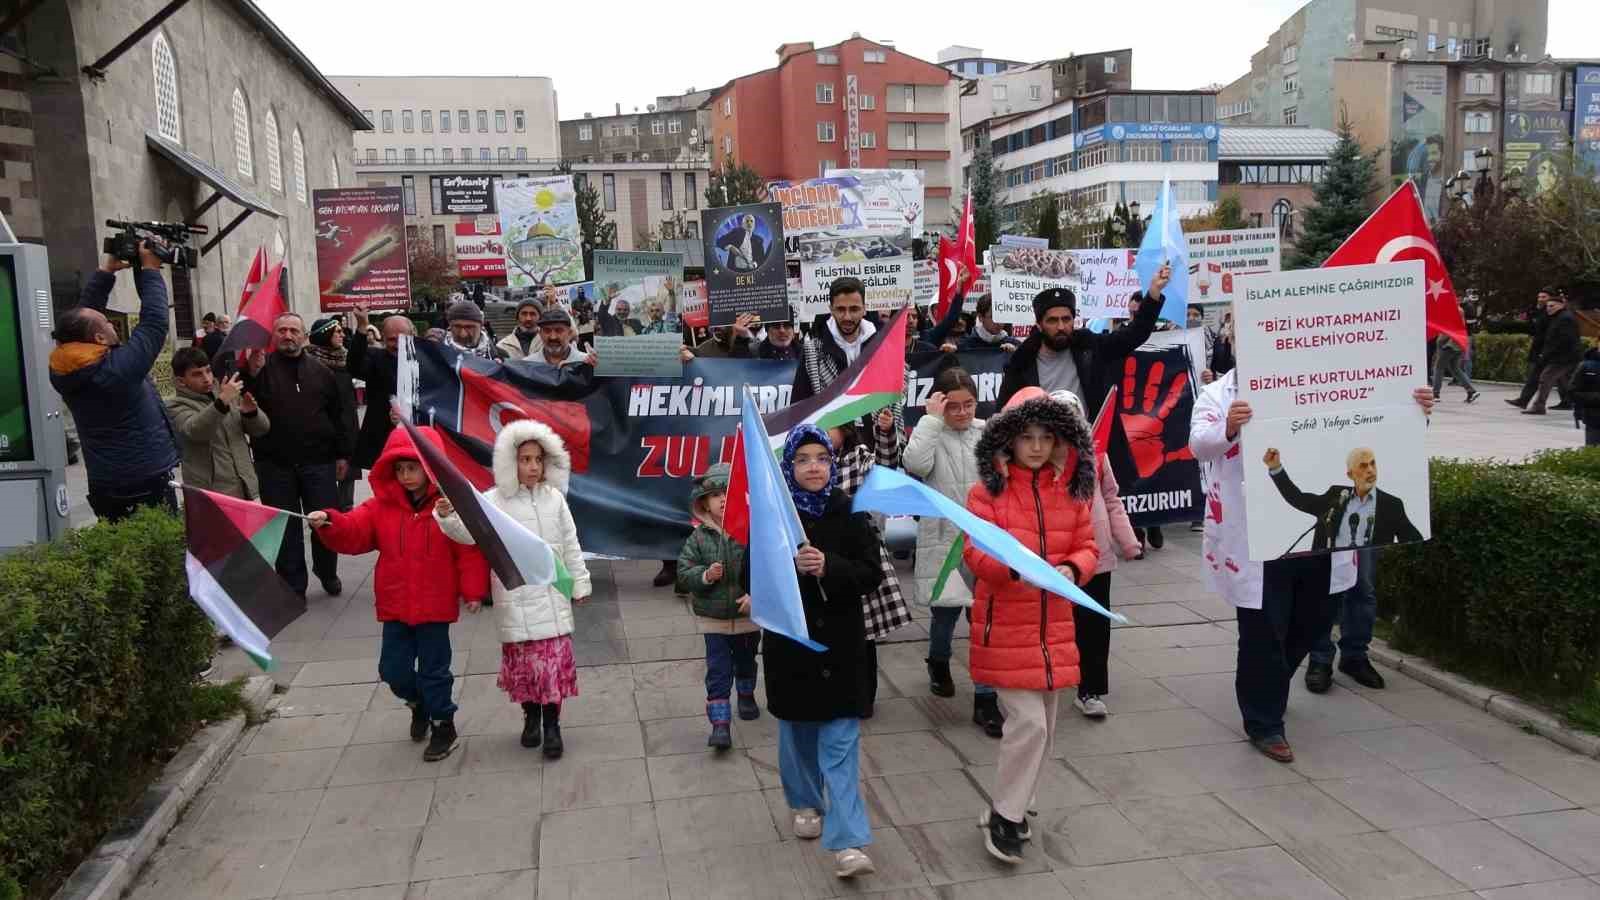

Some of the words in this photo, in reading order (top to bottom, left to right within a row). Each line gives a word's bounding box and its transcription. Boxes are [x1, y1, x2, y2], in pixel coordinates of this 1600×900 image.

[1080, 252, 1119, 265] üminlerin
[815, 263, 862, 278] FİLİSTİNLİ
[864, 264, 901, 275] ESİRLER
[863, 276, 897, 288] EĞİLDİR
[1000, 278, 1041, 290] FİLİSTİNLİ
[1246, 287, 1281, 301] İSLAM
[1284, 282, 1336, 296] ALEMİNE
[1338, 276, 1414, 294] ÇAĞRIMIZDIR
[994, 301, 1013, 313] İÇİN
[1296, 309, 1401, 329] KURTARMANIZI
[1276, 329, 1388, 350] BEKLEMİYORUZ.
[1250, 374, 1305, 391] BİZİMLE
[1309, 364, 1413, 385] KURTULMANIZI
[1323, 417, 1351, 431] Yahya
[1353, 414, 1384, 426] Sinvar
